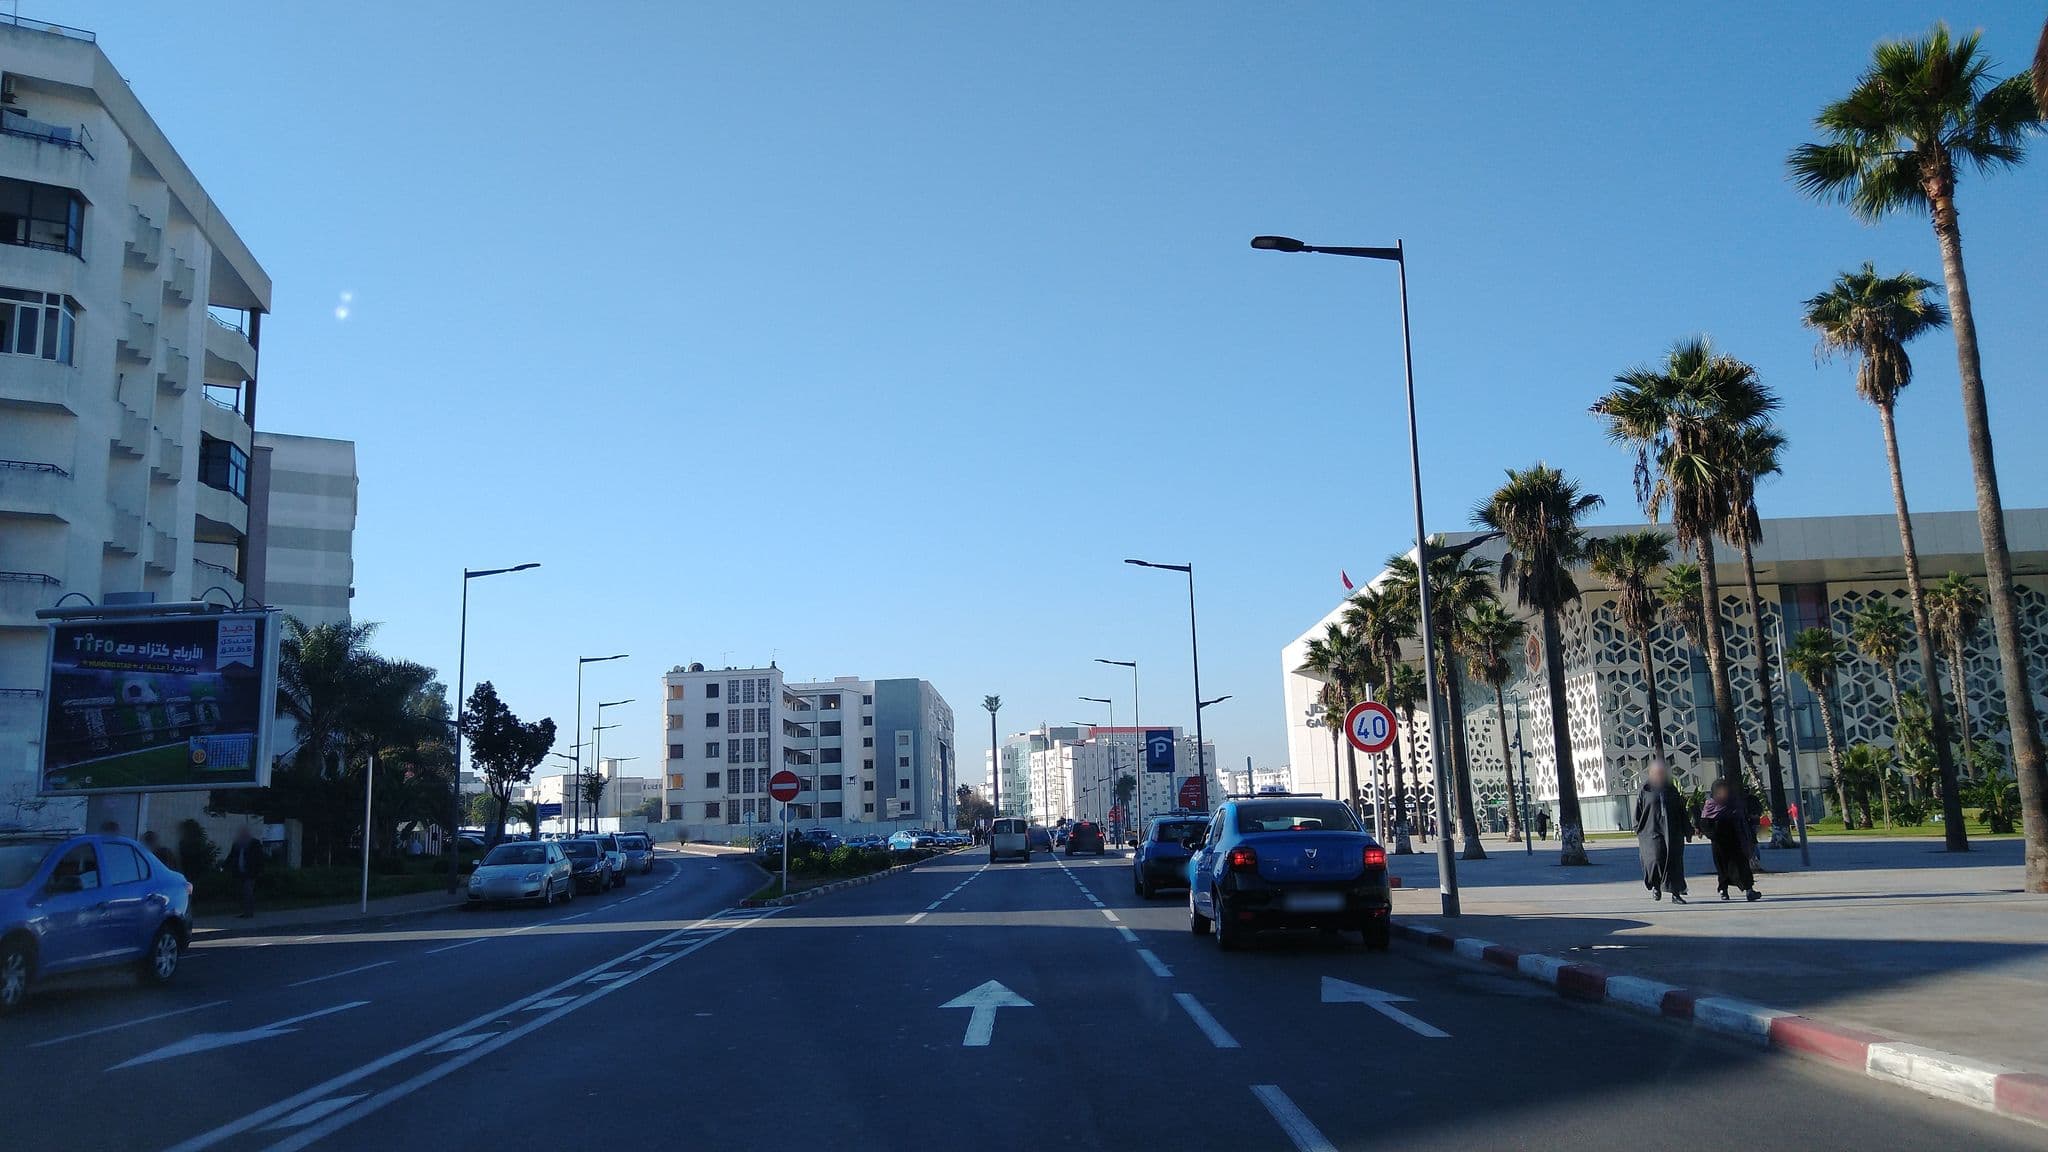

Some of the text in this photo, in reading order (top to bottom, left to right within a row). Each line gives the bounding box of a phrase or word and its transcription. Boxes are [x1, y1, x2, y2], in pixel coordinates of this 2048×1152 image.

[116, 643, 135, 656] مع
[1357, 715, 1386, 739] 40
[1155, 742, 1167, 758] P
